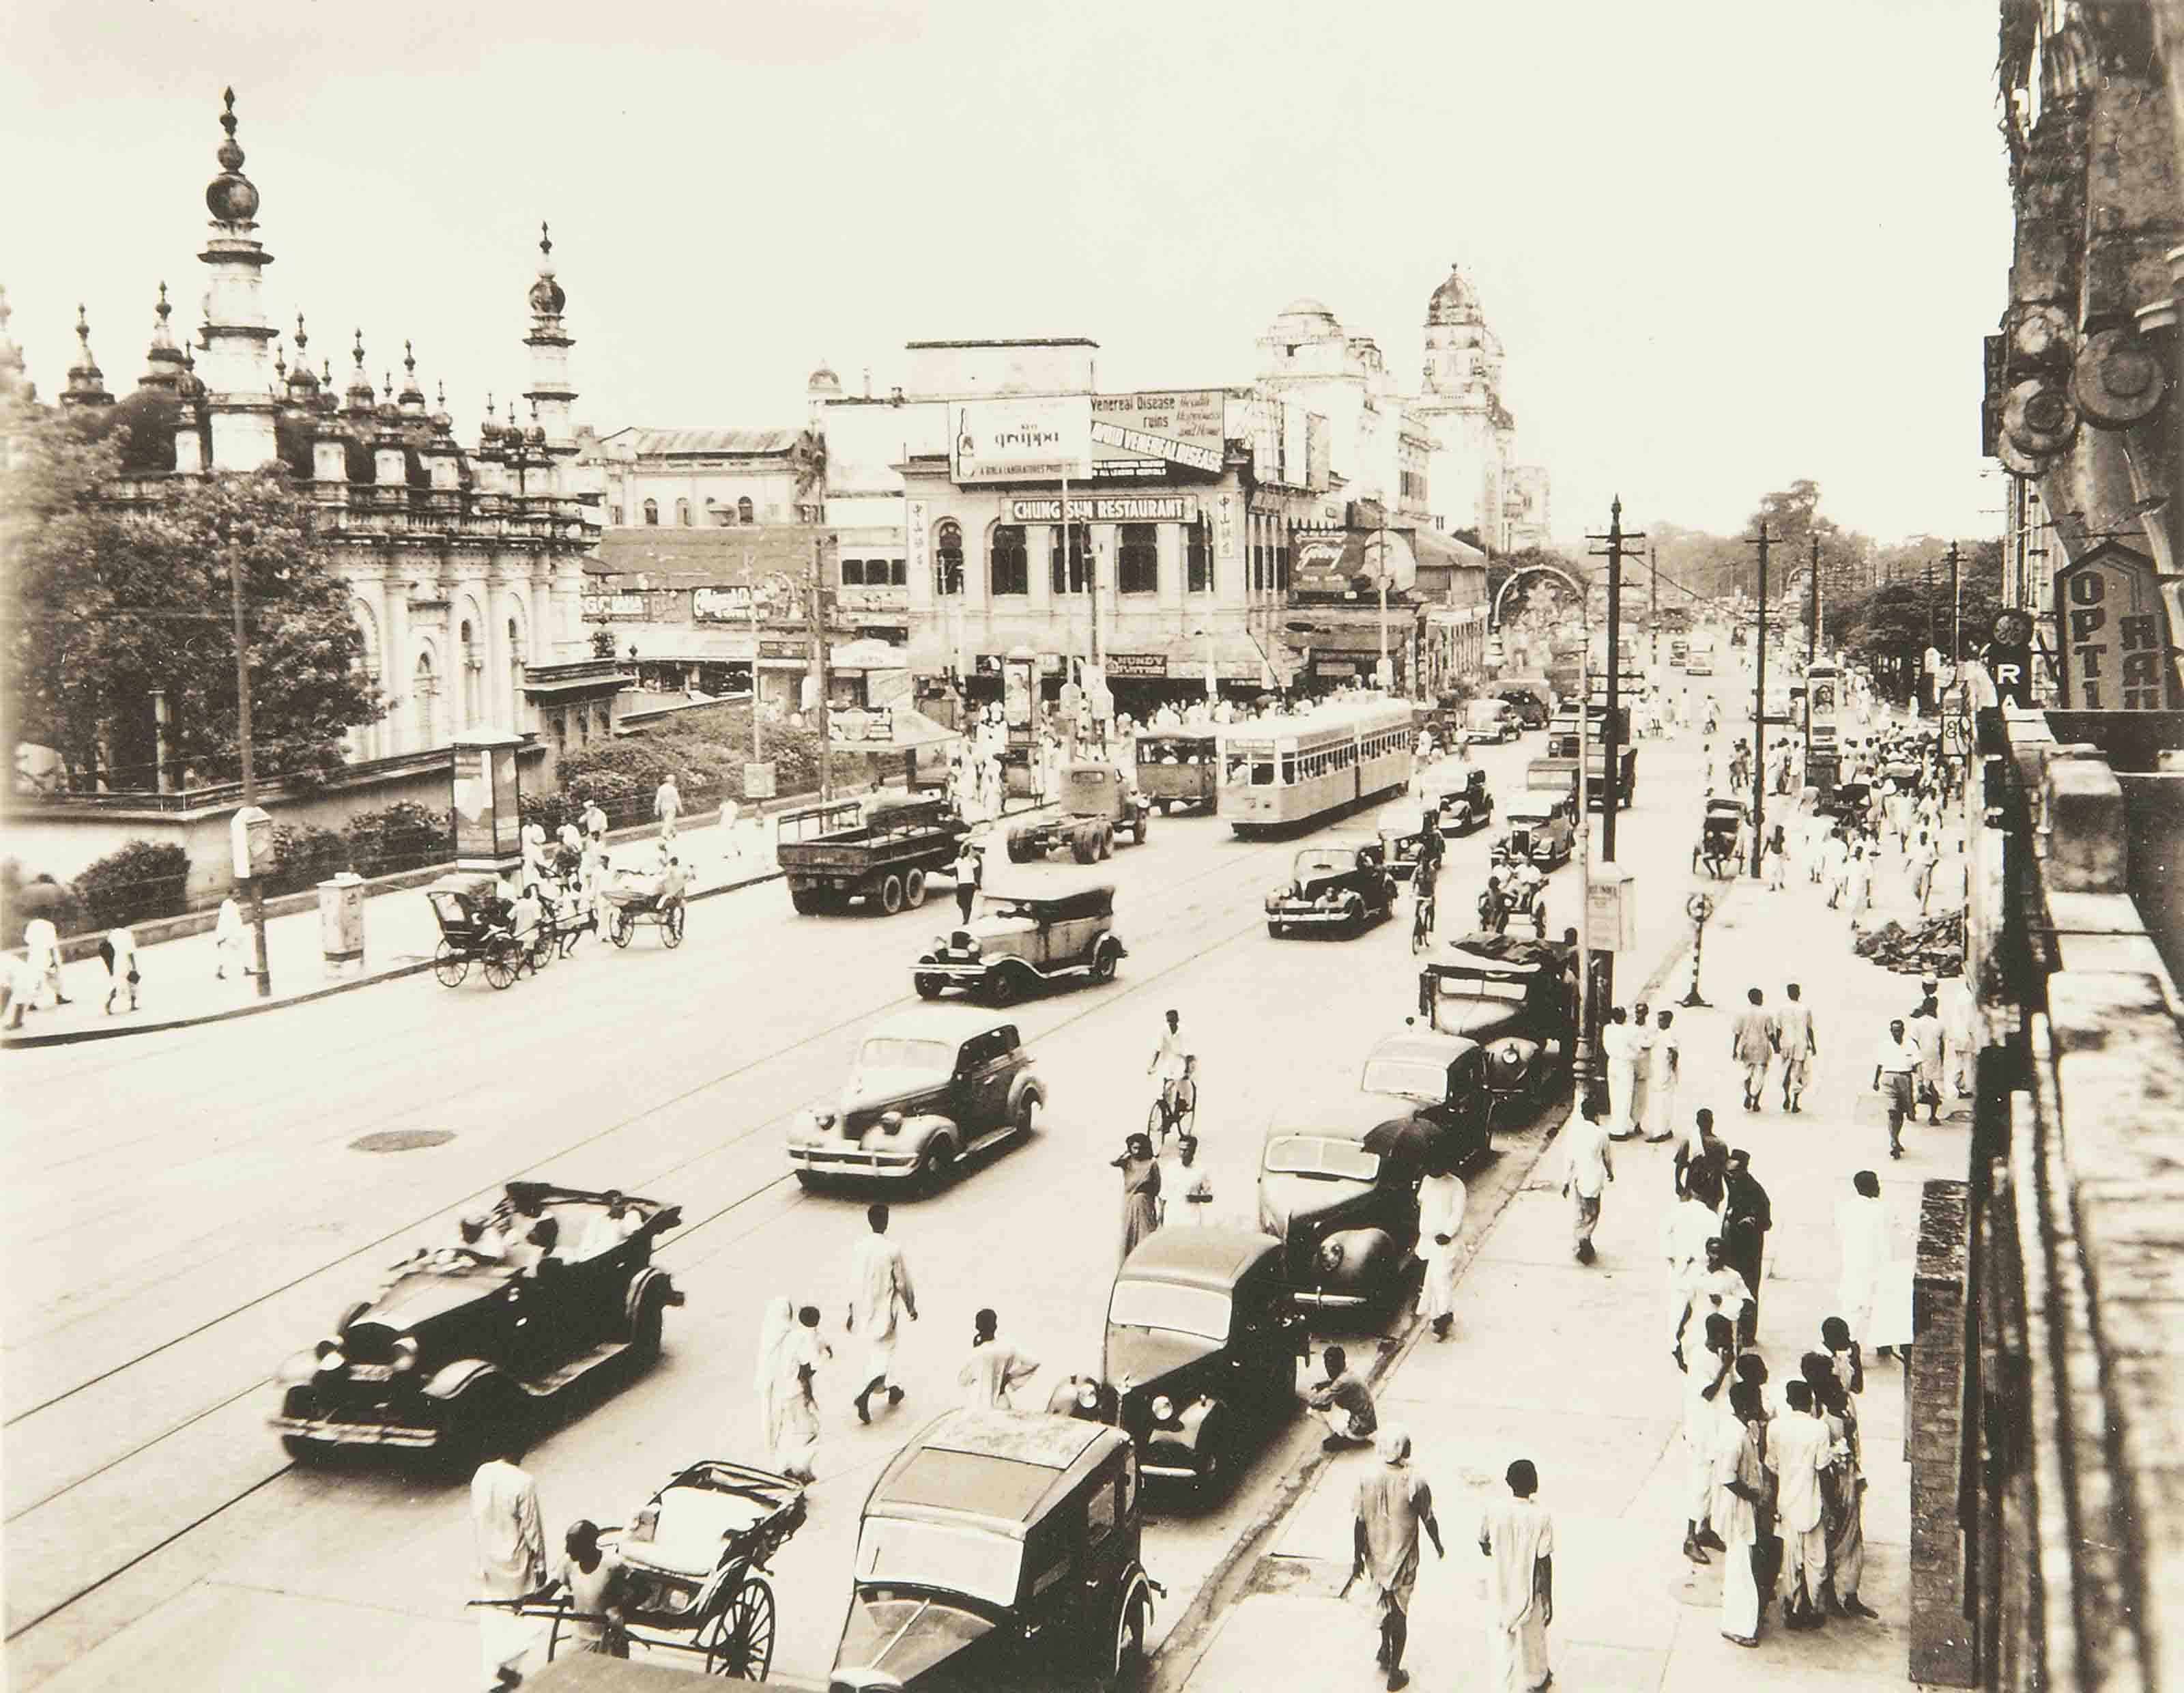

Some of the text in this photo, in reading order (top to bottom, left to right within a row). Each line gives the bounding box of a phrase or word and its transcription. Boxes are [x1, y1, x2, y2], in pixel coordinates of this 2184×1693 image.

[1091, 396, 1175, 410] Venereal Disease
[1143, 415, 1169, 428] ruins
[1014, 501, 1061, 520] CHUNG
[1097, 499, 1183, 519] RESTAURANT
